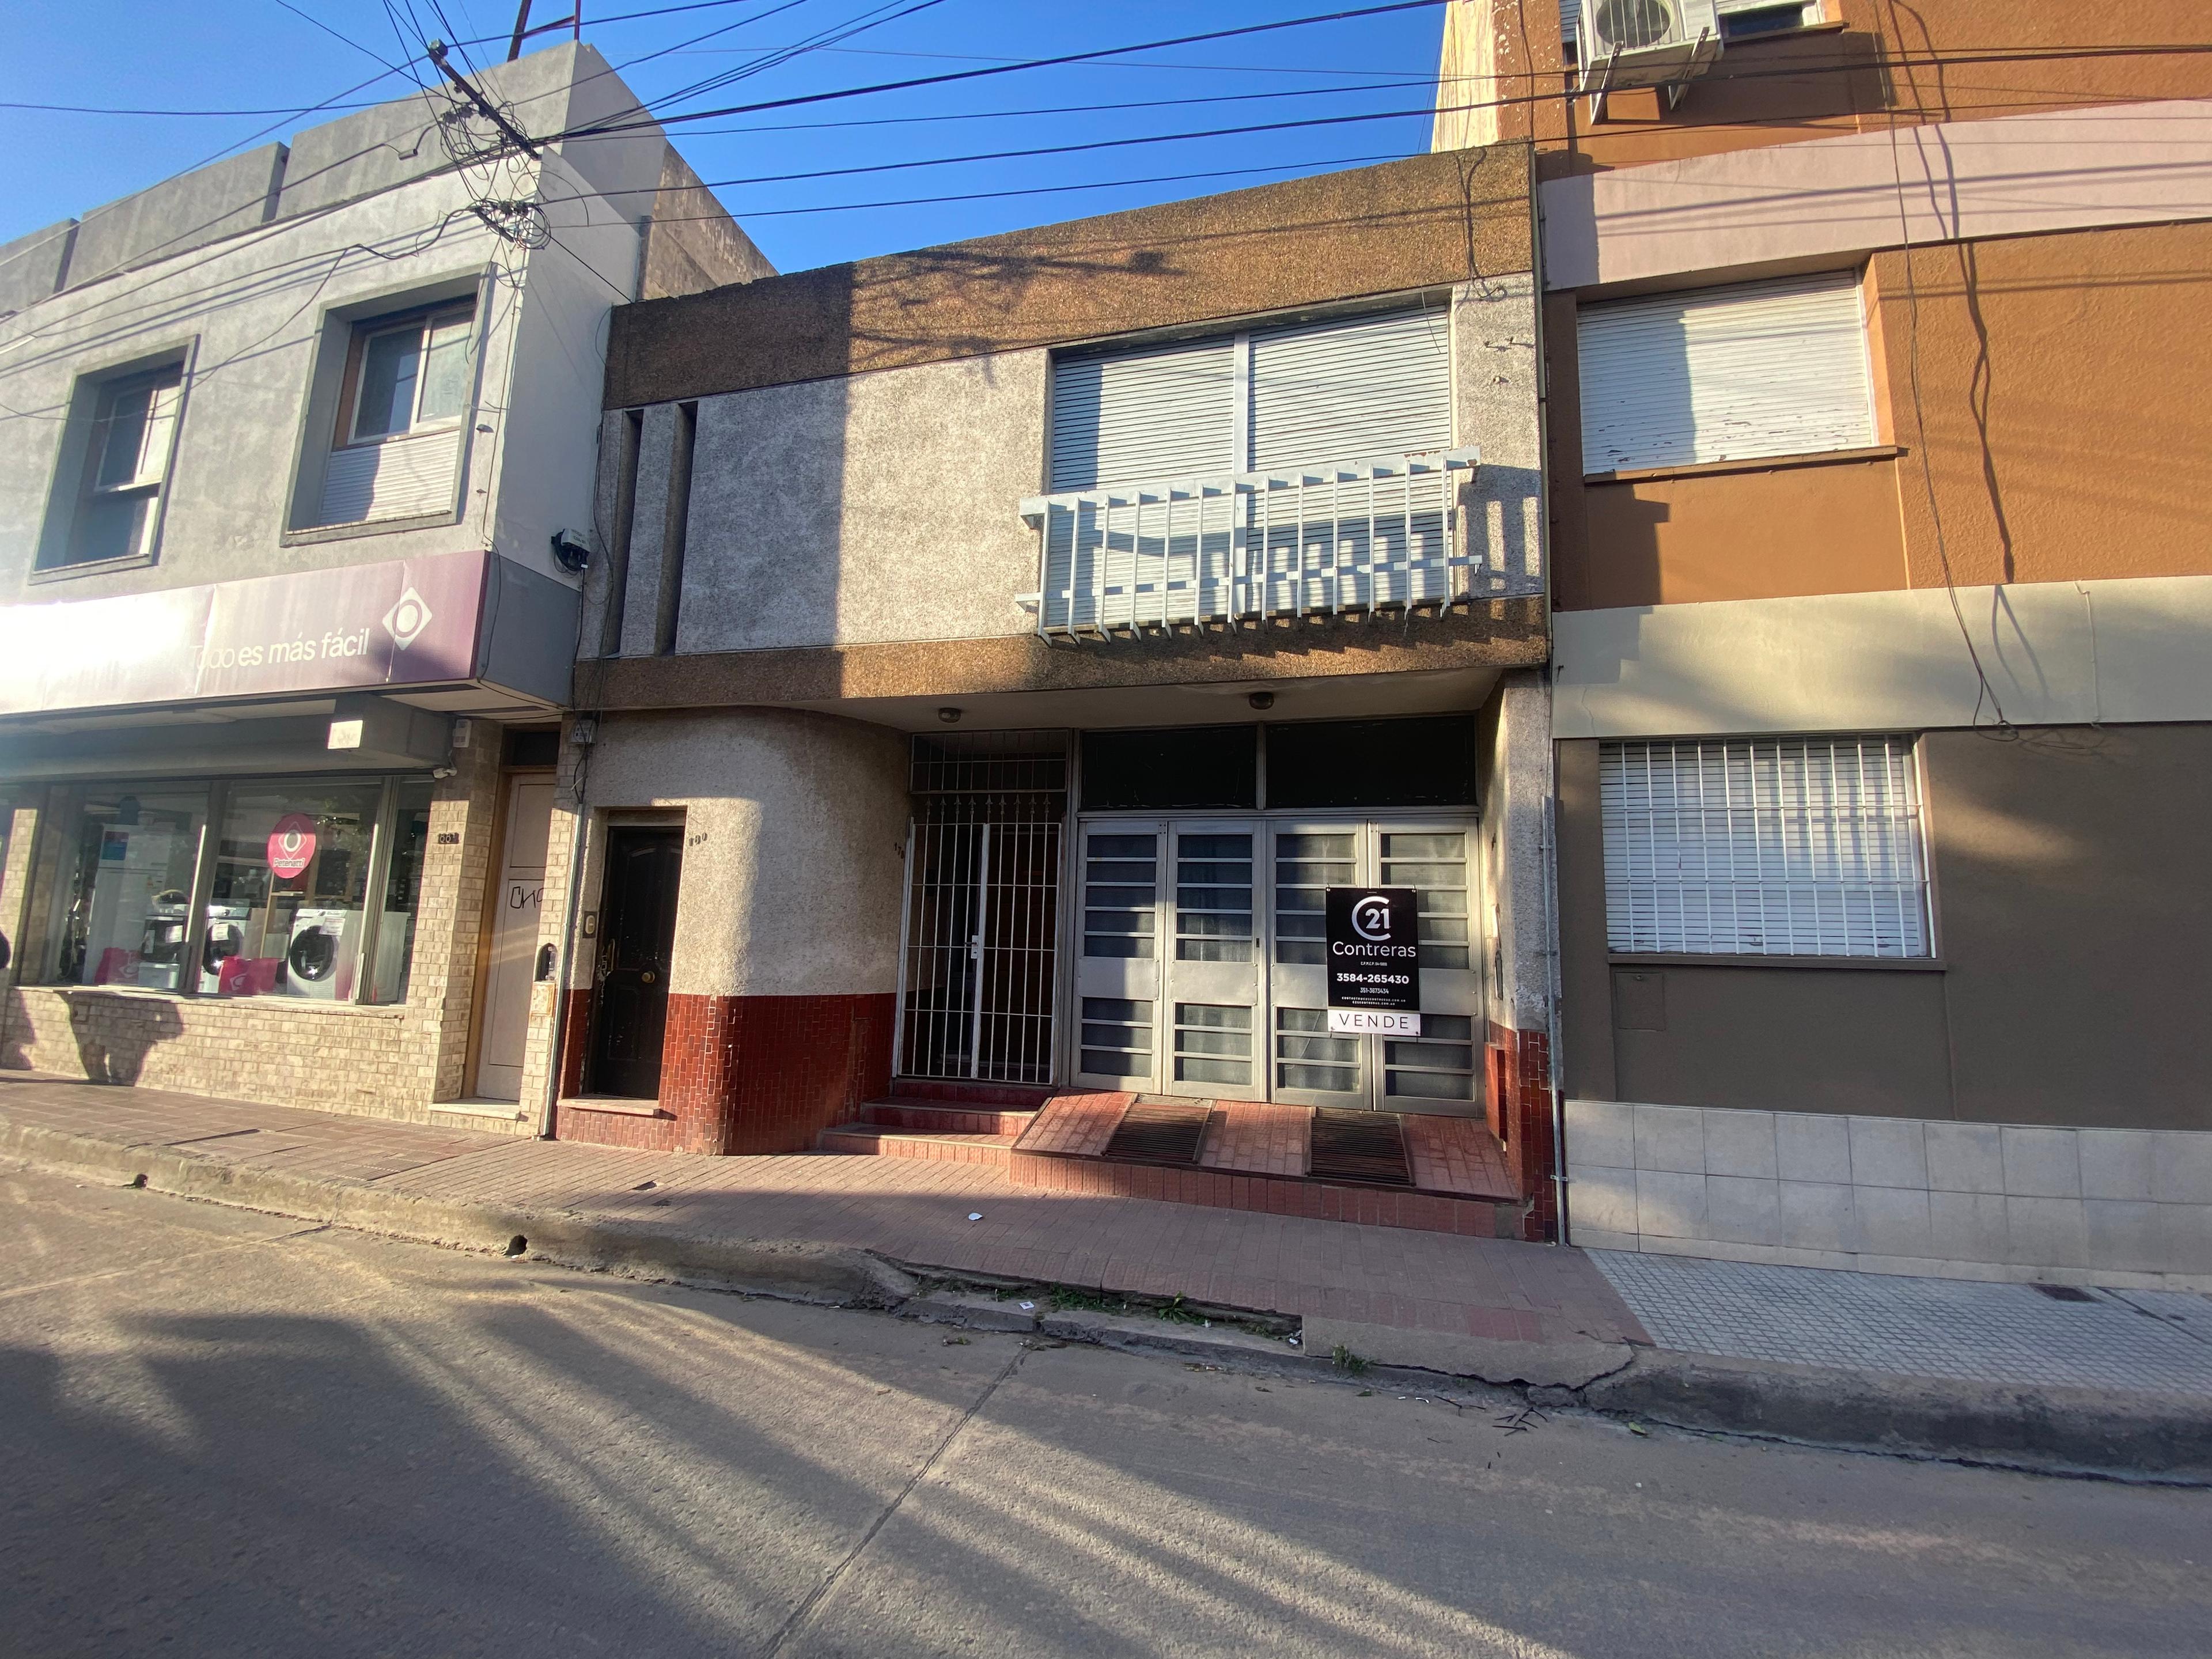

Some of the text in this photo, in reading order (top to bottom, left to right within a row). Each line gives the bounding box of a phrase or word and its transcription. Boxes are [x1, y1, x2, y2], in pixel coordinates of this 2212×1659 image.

[238, 646, 264, 666] es
[268, 632, 316, 664] más
[321, 627, 370, 658] fácil
[1333, 941, 1416, 957] Contreras
[1336, 973, 1410, 984] 3584-265430
[1339, 1014, 1408, 1029] VENDE
